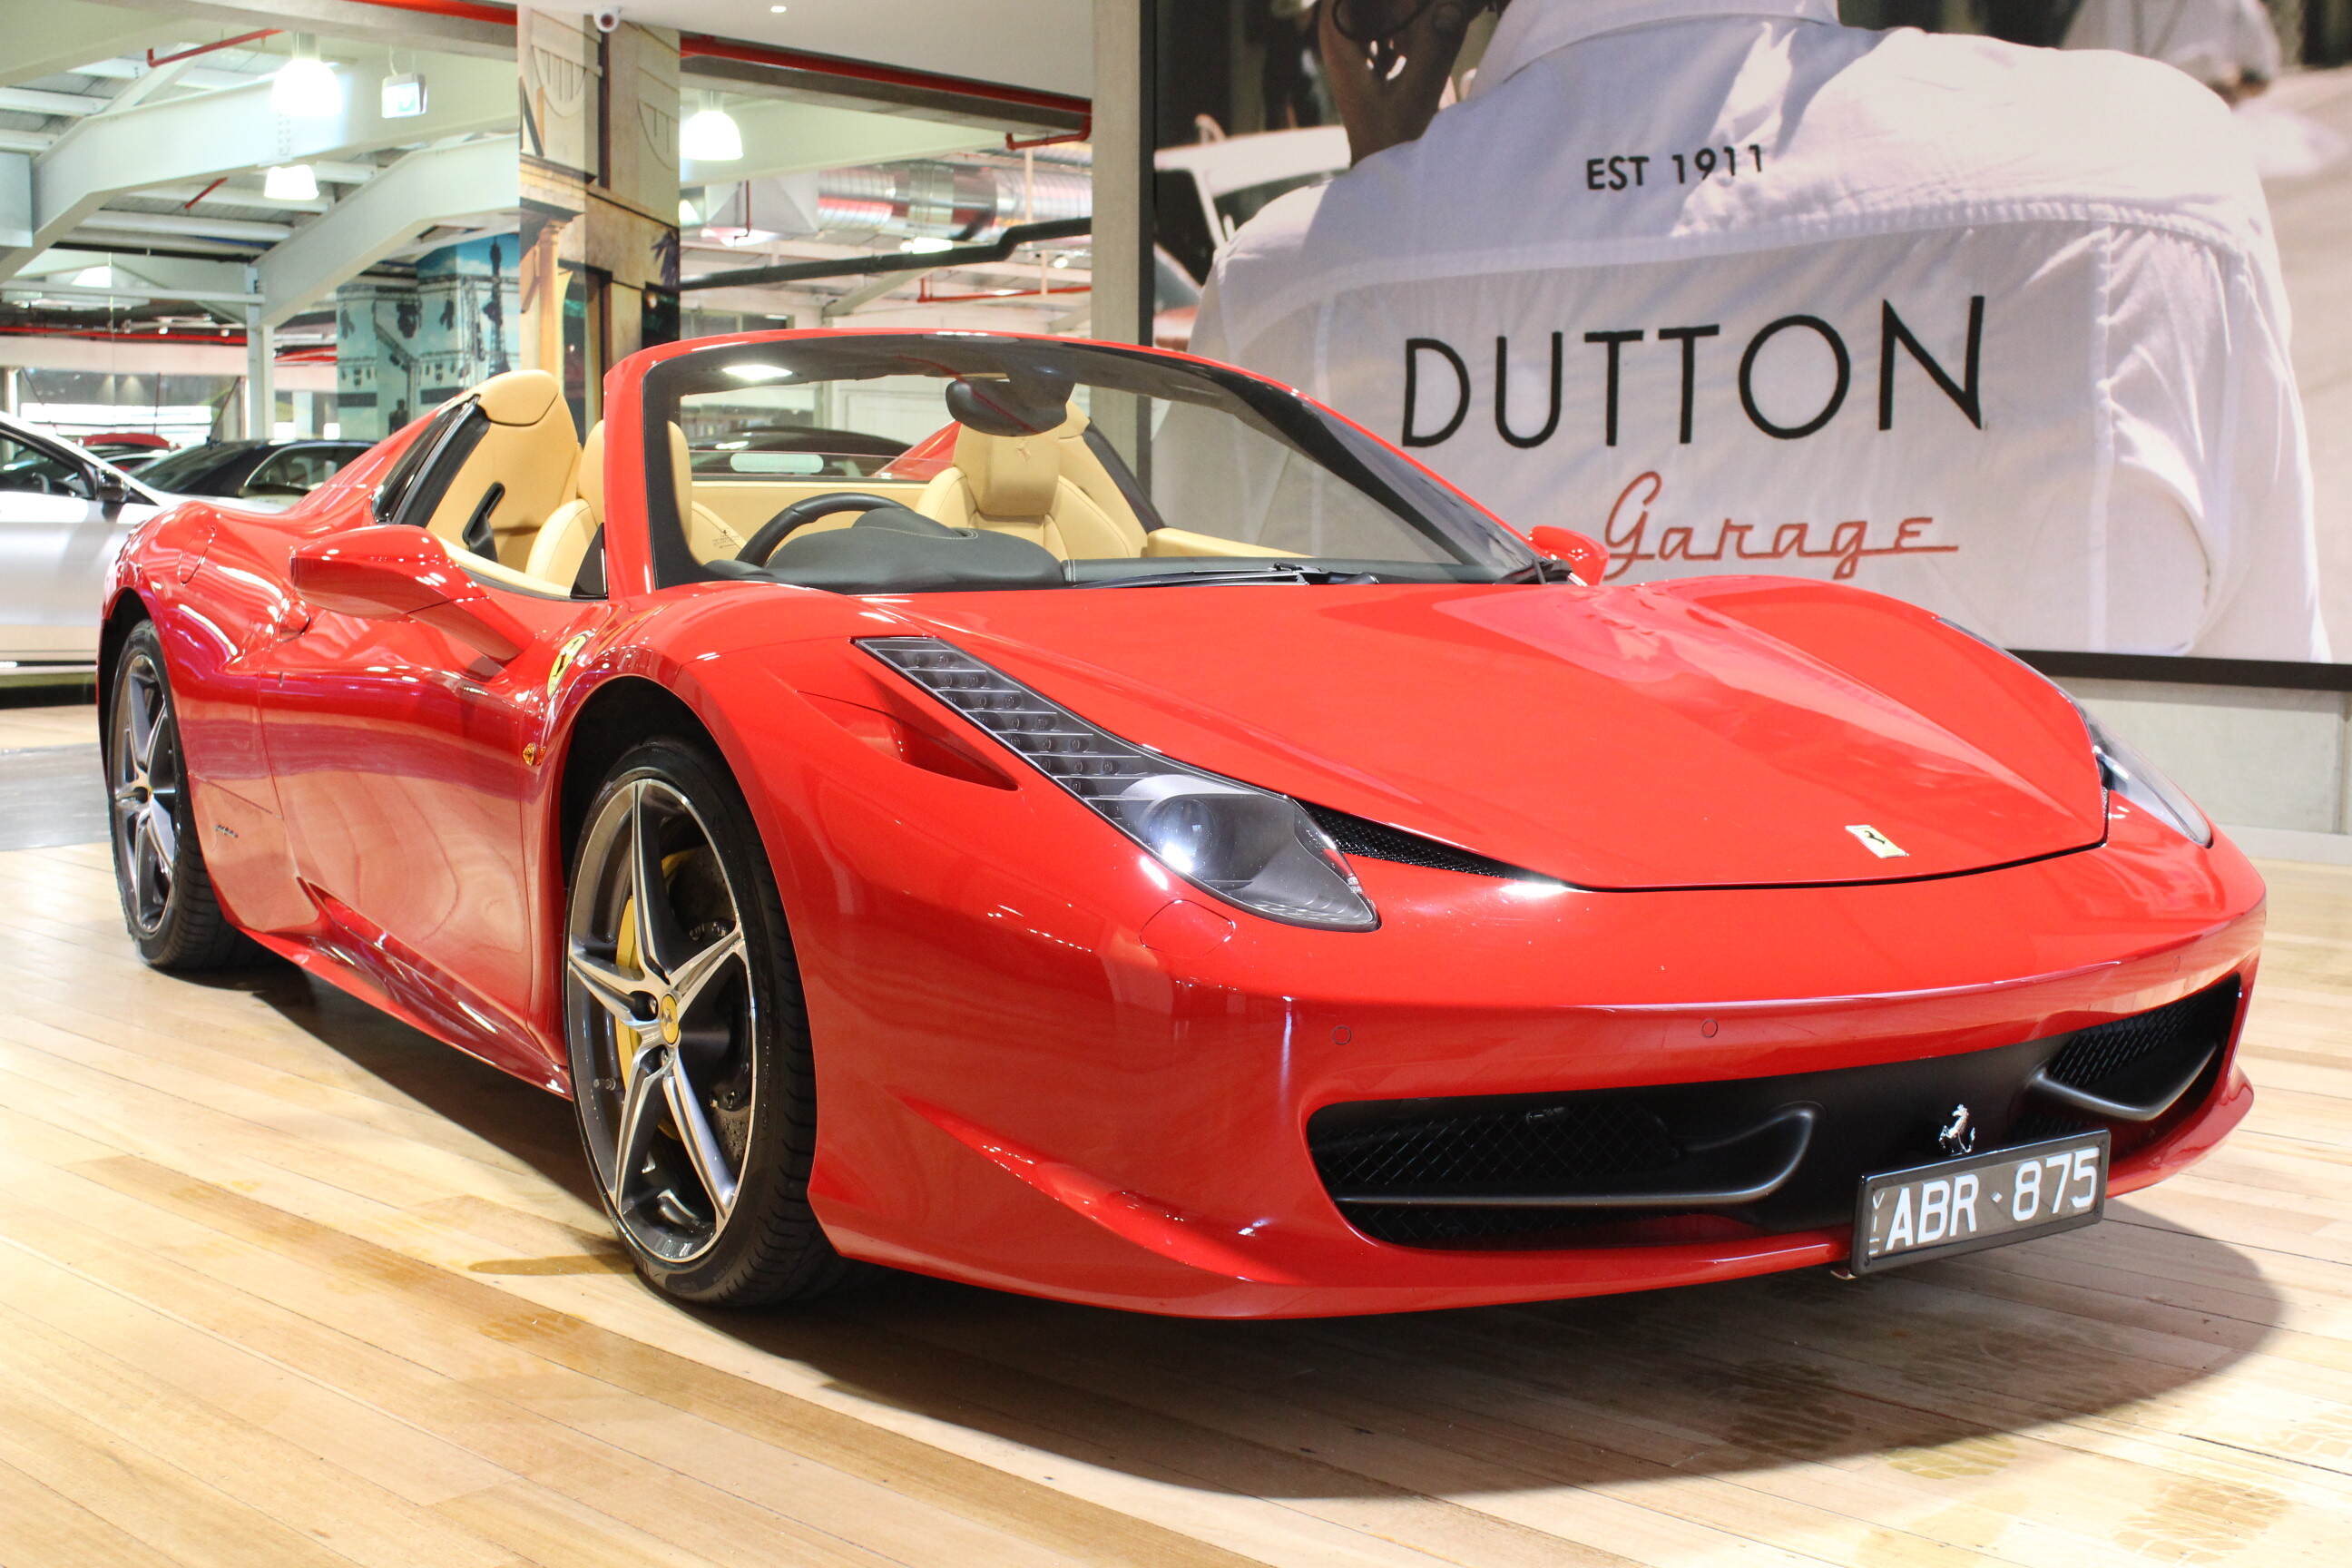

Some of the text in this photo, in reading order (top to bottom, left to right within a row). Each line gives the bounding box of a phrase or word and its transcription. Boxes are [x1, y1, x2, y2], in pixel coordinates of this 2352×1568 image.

[1585, 143, 1763, 191] EST 1911
[1401, 295, 1985, 449] DUTTON
[1602, 470, 1960, 581] Garage
[1885, 1146, 2101, 1251] ABR 875
